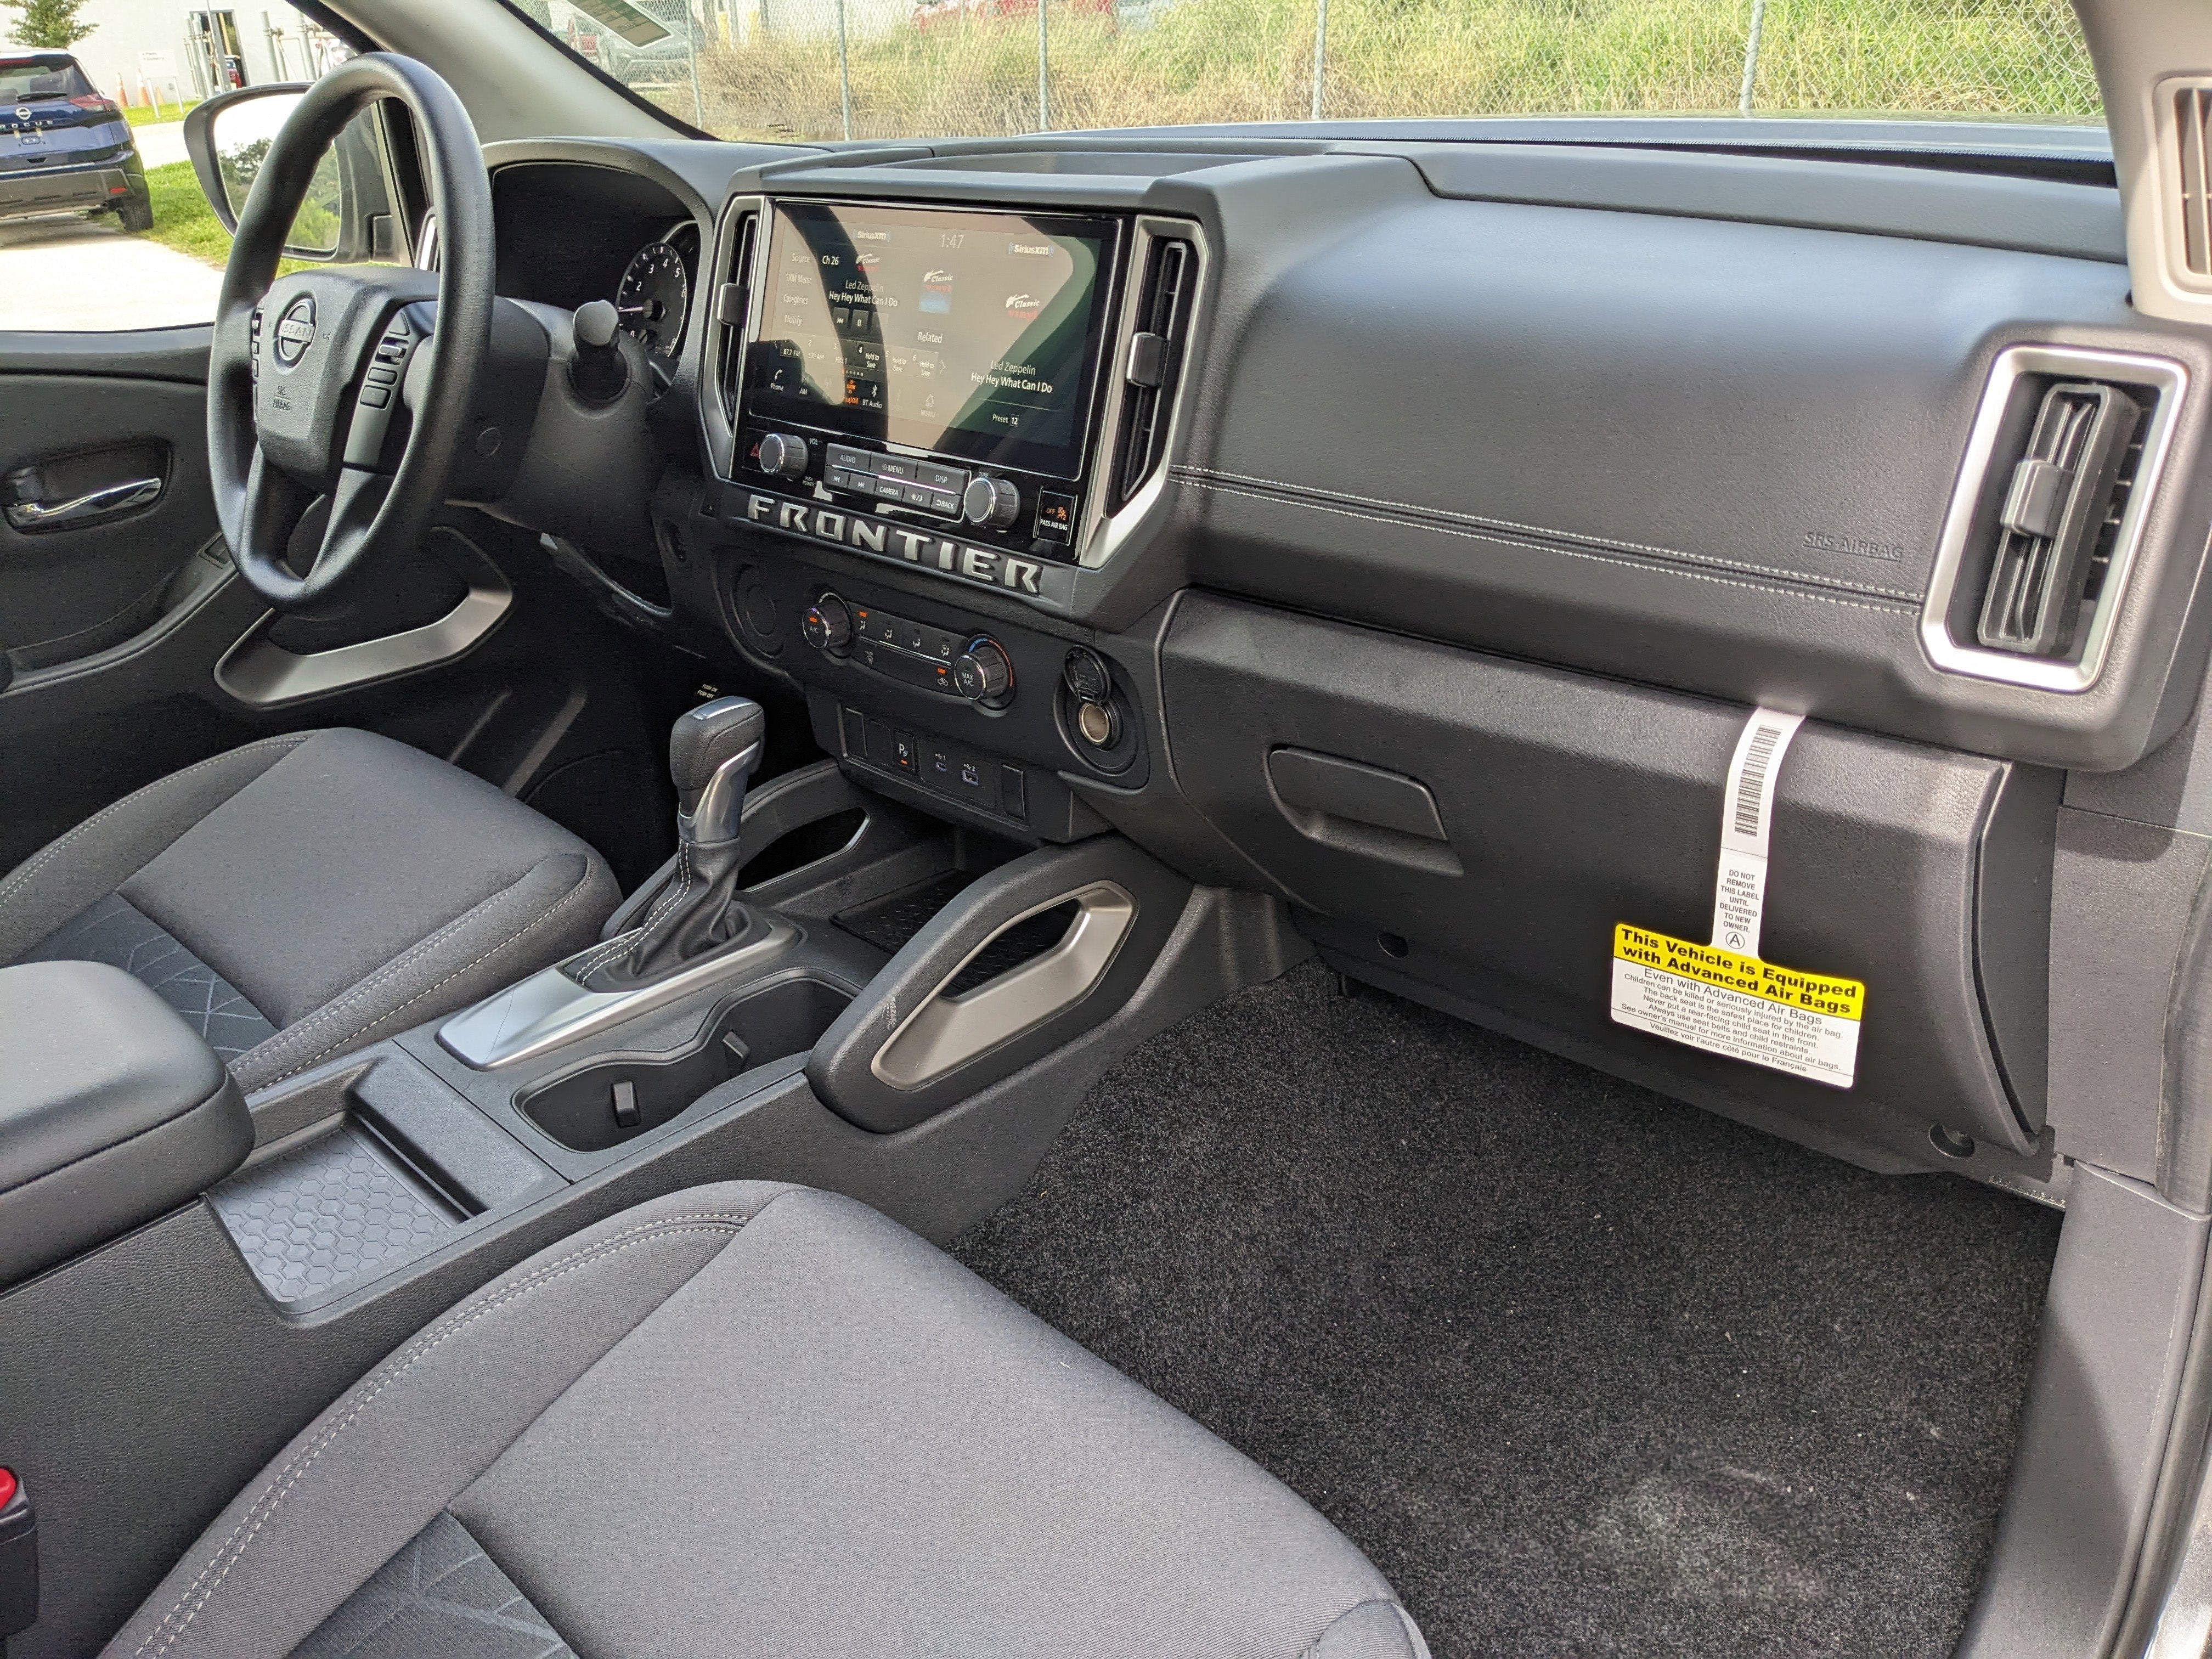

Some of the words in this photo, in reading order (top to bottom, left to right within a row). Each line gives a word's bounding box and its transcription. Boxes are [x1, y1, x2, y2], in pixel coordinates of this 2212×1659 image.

[940, 234, 964, 249] 1:47
[792, 253, 811, 263] Source
[822, 255, 830, 265] Ch
[831, 256, 839, 266] 26
[786, 273, 797, 282] SXM
[797, 275, 811, 284] Menu
[931, 274, 953, 283] Classic
[635, 281, 642, 292] 2
[845, 280, 856, 290] Led
[857, 281, 884, 294] Zeppelin
[783, 294, 808, 306] Categories
[829, 291, 840, 303] Hey
[841, 292, 853, 304] Hey
[854, 294, 871, 304] What
[872, 296, 884, 306] Can
[888, 297, 898, 307] Do
[1014, 299, 1040, 308] Classic
[784, 314, 803, 327] Notify
[917, 331, 944, 343] Related
[865, 352, 874, 360] Hold
[866, 360, 876, 369] Save
[919, 360, 929, 369] Hold
[991, 360, 1003, 371] Led
[1005, 362, 1036, 376] Zeppelin
[770, 382, 784, 392] Phone
[971, 372, 985, 385] Hey
[985, 374, 1000, 387] Hey
[1001, 376, 1021, 389] What
[1021, 380, 1036, 391] Can
[1037, 381, 1041, 392] I
[1041, 382, 1053, 393] Do
[277, 385, 286, 397] SRS
[868, 400, 883, 409] Audio
[920, 409, 936, 418] MENU
[992, 414, 1008, 424] Preset
[1011, 417, 1019, 425] 12
[809, 437, 819, 445] VOL
[839, 454, 856, 464] AUDIO
[887, 464, 904, 475] MENU
[935, 475, 948, 483] DISP
[879, 486, 899, 496] CAMERA
[941, 501, 955, 510] BACK
[1040, 518, 1051, 527] PASS
[1058, 523, 1068, 531] BAG
[747, 493, 1044, 594] FRONTIER
[1802, 531, 1835, 549] SRS
[1837, 536, 1905, 560] AIRBAG
[810, 625, 819, 634] A/C
[962, 672, 974, 681] MAX
[963, 679, 974, 687] A/C
[1729, 869, 1740, 878] DO
[1740, 872, 1756, 882] NOT
[1726, 878, 1756, 891] REMOVE
[1720, 885, 1736, 895] THIS
[1737, 889, 1760, 901] LABEL
[1729, 896, 1750, 907] UNTIL
[1719, 902, 1758, 918] DELIVERED
[1724, 912, 1734, 921] TO
[1735, 915, 1751, 925] NEW
[1723, 920, 1751, 933] OWNER.
[1729, 934, 1741, 947] A
[1621, 928, 1659, 949] This
[1666, 940, 1733, 970] Vehicle
[1739, 961, 1756, 975] is
[1763, 967, 1857, 998] Equipped
[1622, 946, 1661, 965] with
[1666, 957, 1759, 992] Advanced
[1764, 984, 1794, 1001] Air
[1799, 992, 1851, 1014] Bags
[1644, 968, 1674, 985] Even
[1677, 978, 1701, 993] with
[1703, 986, 1765, 1010] Advanced
[1767, 1002, 1786, 1015] Air
[1789, 1008, 1823, 1025] Bags
[1624, 973, 1655, 988] Children
[1657, 983, 1671, 992] can
[1673, 986, 1683, 996] be
[1684, 989, 1705, 1002] killed
[1716, 1000, 1752, 1015] seriously
[1754, 1010, 1782, 1023] injured
[1784, 1017, 1794, 1028] by
[1796, 1019, 1809, 1030] the
[1811, 1024, 1823, 1034] air
[1824, 1026, 1843, 1040] bag.
[1643, 986, 1658, 996] The
[1660, 990, 1678, 1002] back
[1679, 997, 1697, 1008] seat
[1706, 1005, 1719, 1014] the
[1721, 1009, 1746, 1022] safest
[1747, 1015, 1769, 1028] place
[1771, 1022, 1782, 1031] for
[1784, 1025, 1820, 1041] children.
[1643, 994, 1666, 1006] Never
[1667, 1002, 1680, 1011] put
[1688, 1007, 1730, 1026] rear-facing
[1732, 1020, 1751, 1031] child
[1753, 1026, 1770, 1036] seat
[1781, 1032, 1795, 1042] the
[1797, 1036, 1819, 1049] front.
[1648, 1003, 1675, 1017] Always
[1677, 1013, 1691, 1022] use
[1692, 1017, 1710, 1028] seat
[1711, 1021, 1730, 1033] belts
[1732, 1028, 1748, 1037] and
[1750, 1031, 1769, 1043] child
[1770, 1039, 1812, 1055] restraints.
[1621, 1002, 1637, 1013] See
[1638, 1009, 1667, 1023] owner's
[1668, 1018, 1697, 1031] manual
[1698, 1025, 1709, 1035] for
[1711, 1031, 1731, 1041] more
[1733, 1035, 1778, 1054] information
[1779, 1048, 1803, 1061] about
[1804, 1055, 1817, 1064] air
[1818, 1058, 1841, 1071] bags.
[1649, 1022, 1679, 1037] Veuillez
[1680, 1031, 1695, 1041] voir
[1696, 1036, 1720, 1048] l'autre
[1722, 1042, 1740, 1054] côté
[1741, 1049, 1760, 1059] pour
[1762, 1052, 1770, 1062] le
[1771, 1056, 1808, 1073] Français
